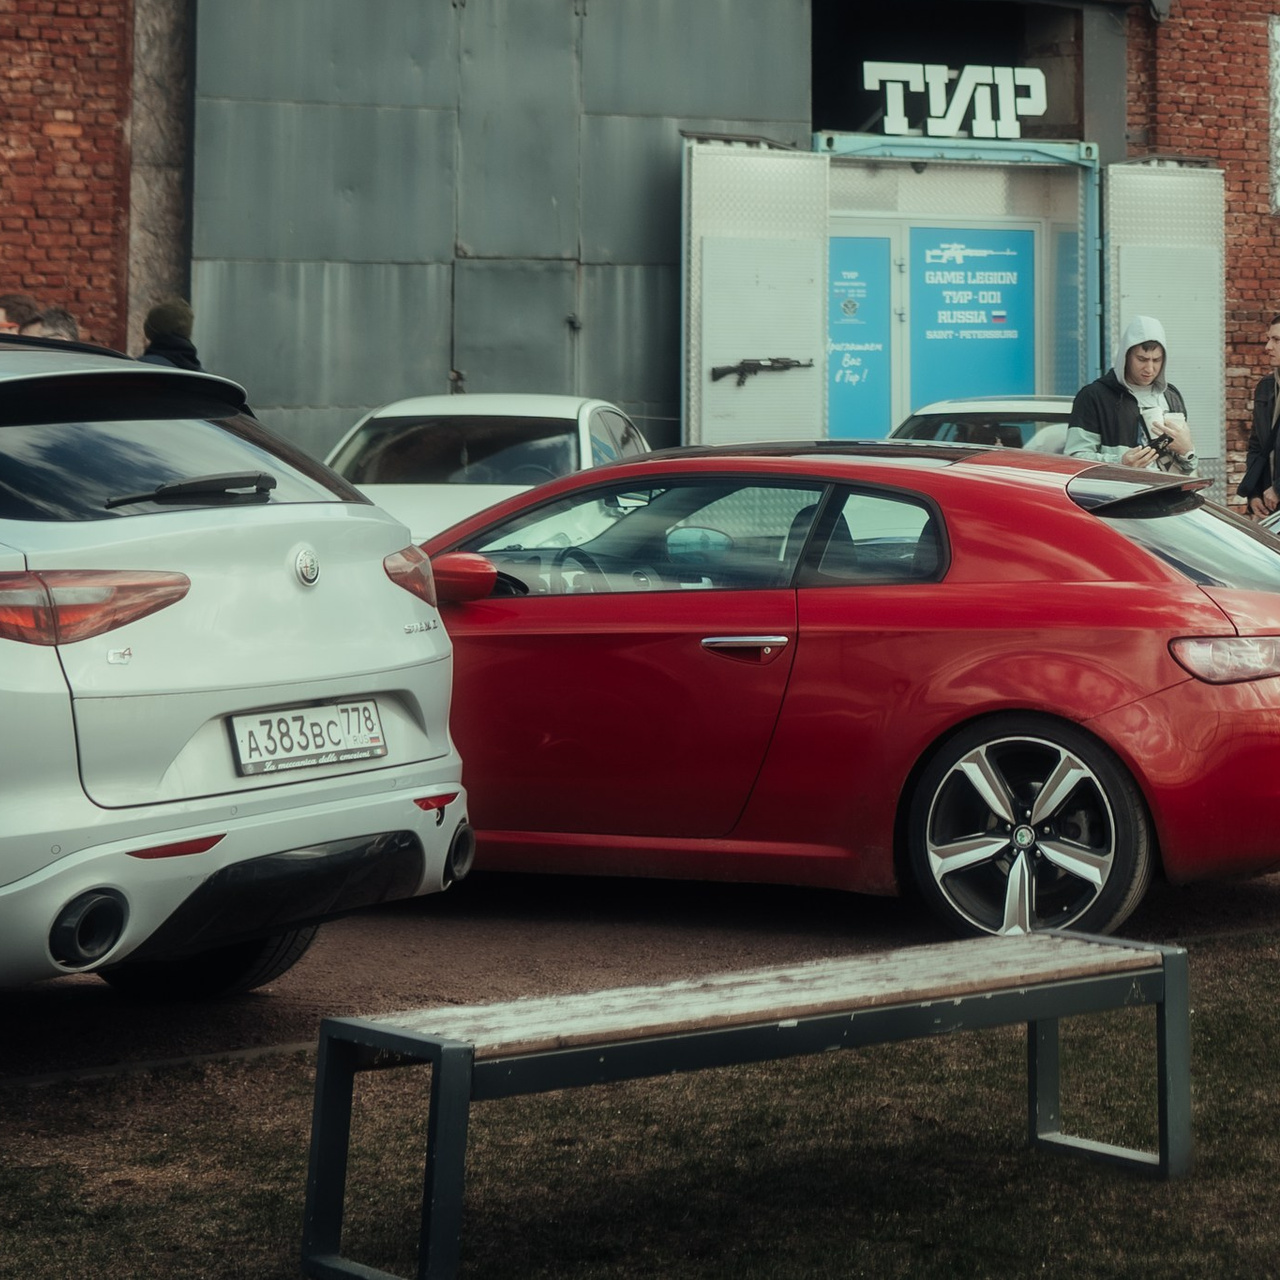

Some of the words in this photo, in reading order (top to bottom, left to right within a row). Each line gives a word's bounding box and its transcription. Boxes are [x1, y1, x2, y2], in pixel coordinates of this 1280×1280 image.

[863, 61, 1047, 138] ТИР
[925, 271, 965, 284] GAME
[967, 271, 1018, 285] LEGION
[938, 310, 988, 323] RUSSIA
[340, 706, 375, 735] 778
[353, 734, 369, 745] RUS
